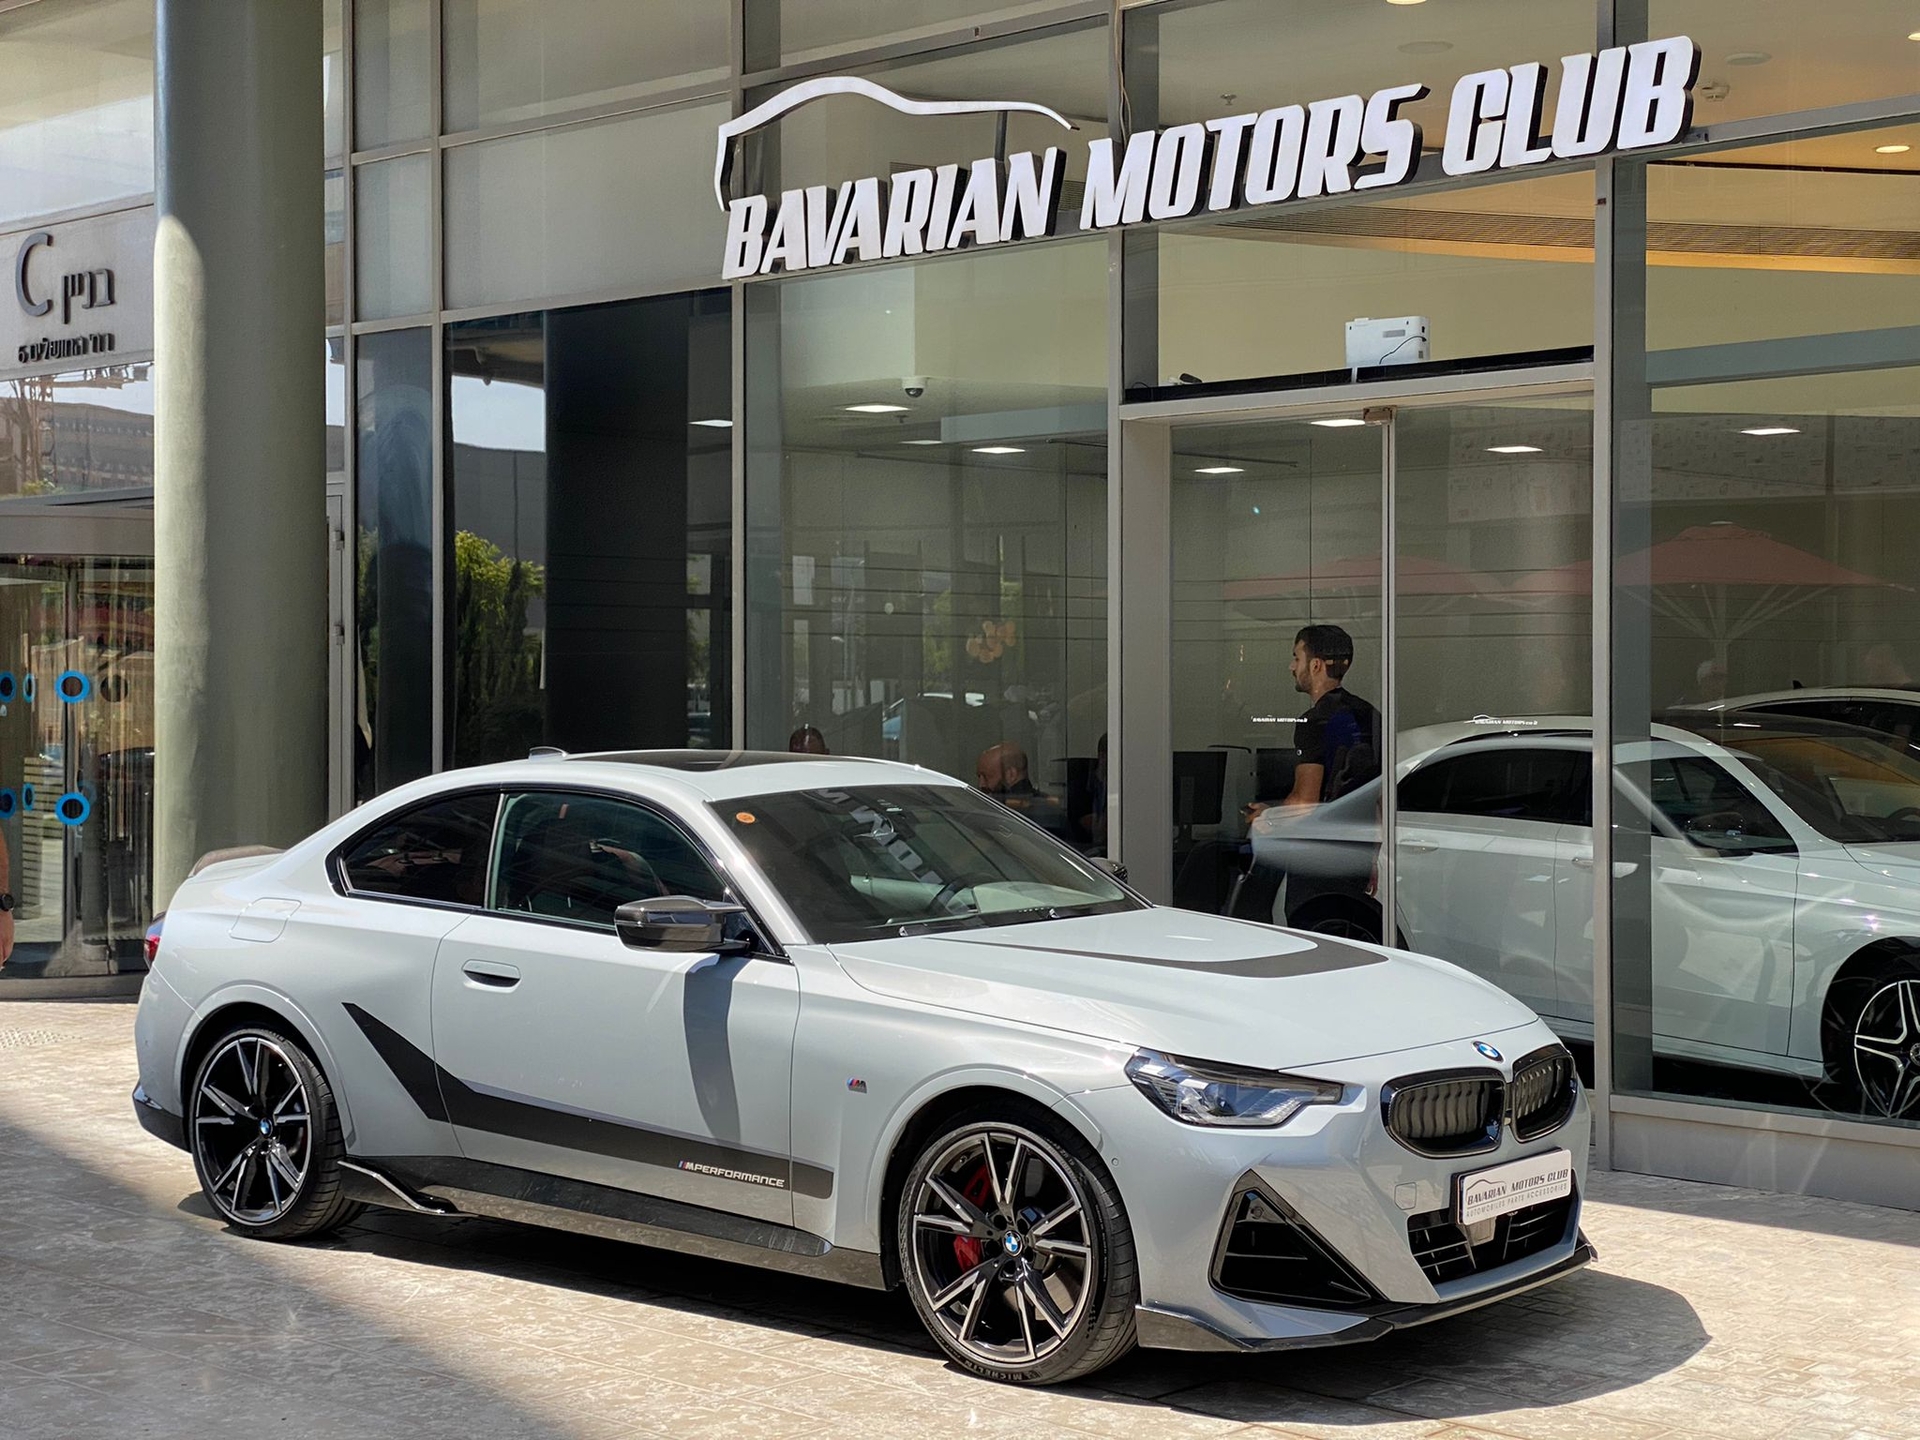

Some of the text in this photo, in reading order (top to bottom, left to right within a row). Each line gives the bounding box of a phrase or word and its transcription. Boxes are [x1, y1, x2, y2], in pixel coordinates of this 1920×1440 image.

[722, 35, 1698, 280] BAVARIAN MOTORS CLUB
[15, 232, 115, 325] בניין C
[1466, 1182, 1567, 1217] AUTOMOBILES PARTS ACCESSORIES
[1467, 1168, 1568, 1206] BAVARIAN MOTORS CLUB
[964, 1359, 1023, 1381] MICHELIN
